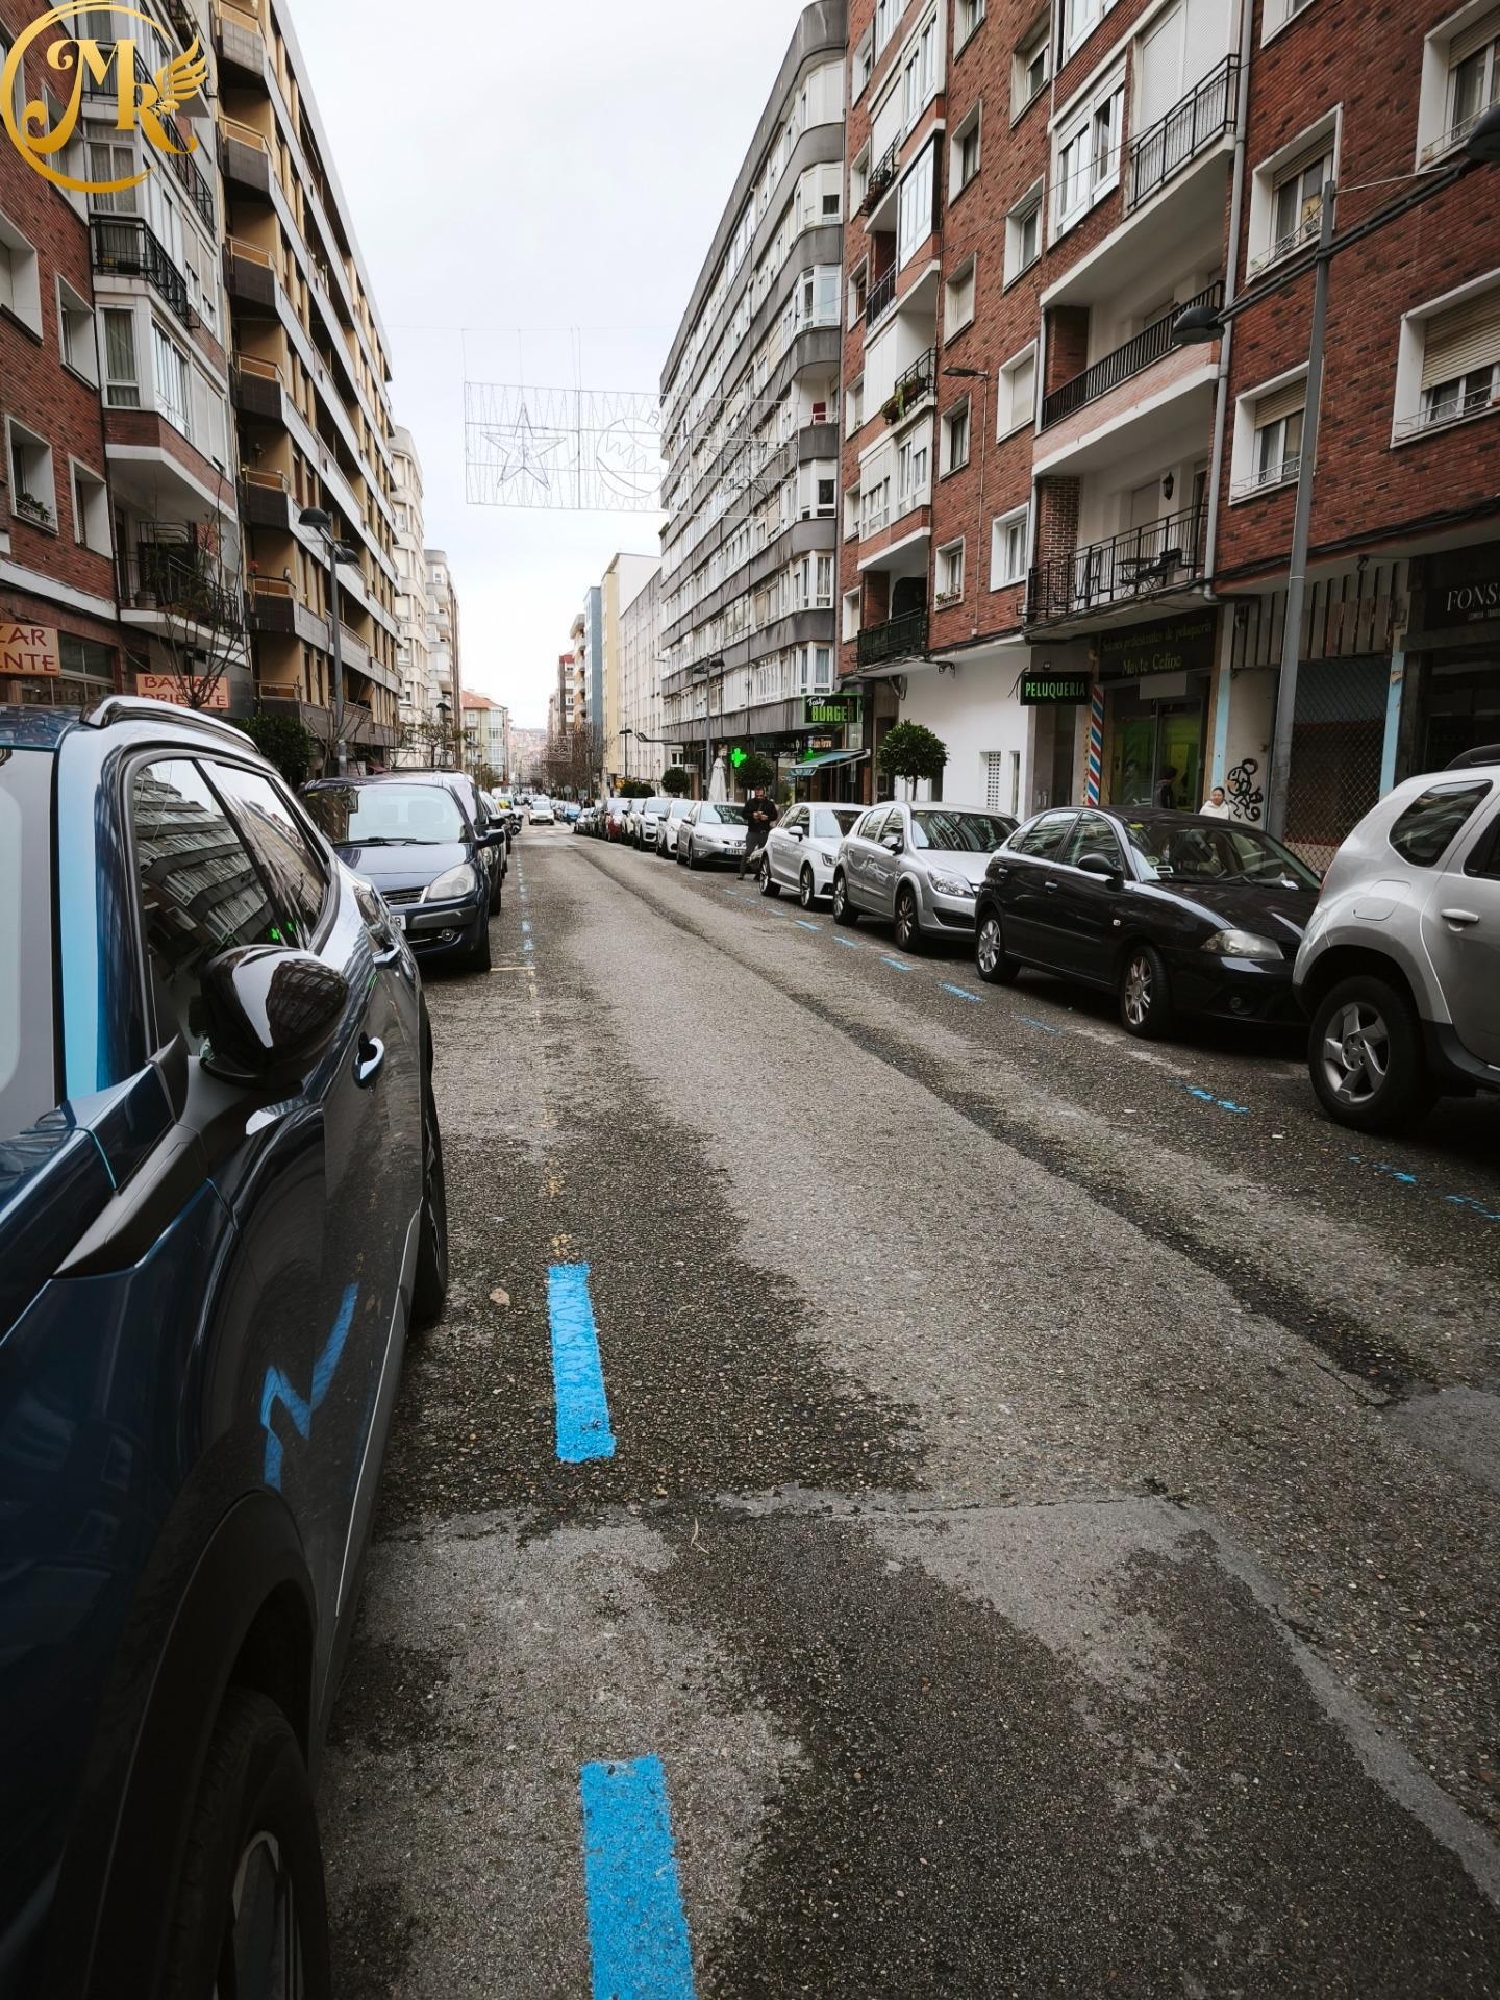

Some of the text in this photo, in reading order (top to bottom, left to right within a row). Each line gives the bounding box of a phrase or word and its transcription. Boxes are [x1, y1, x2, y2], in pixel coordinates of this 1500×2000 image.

[1446, 582, 1500, 612] FONS
[0, 651, 57, 672] NTE
[1025, 681, 1086, 698] PELUQUERIA
[812, 705, 854, 722] BURGER
